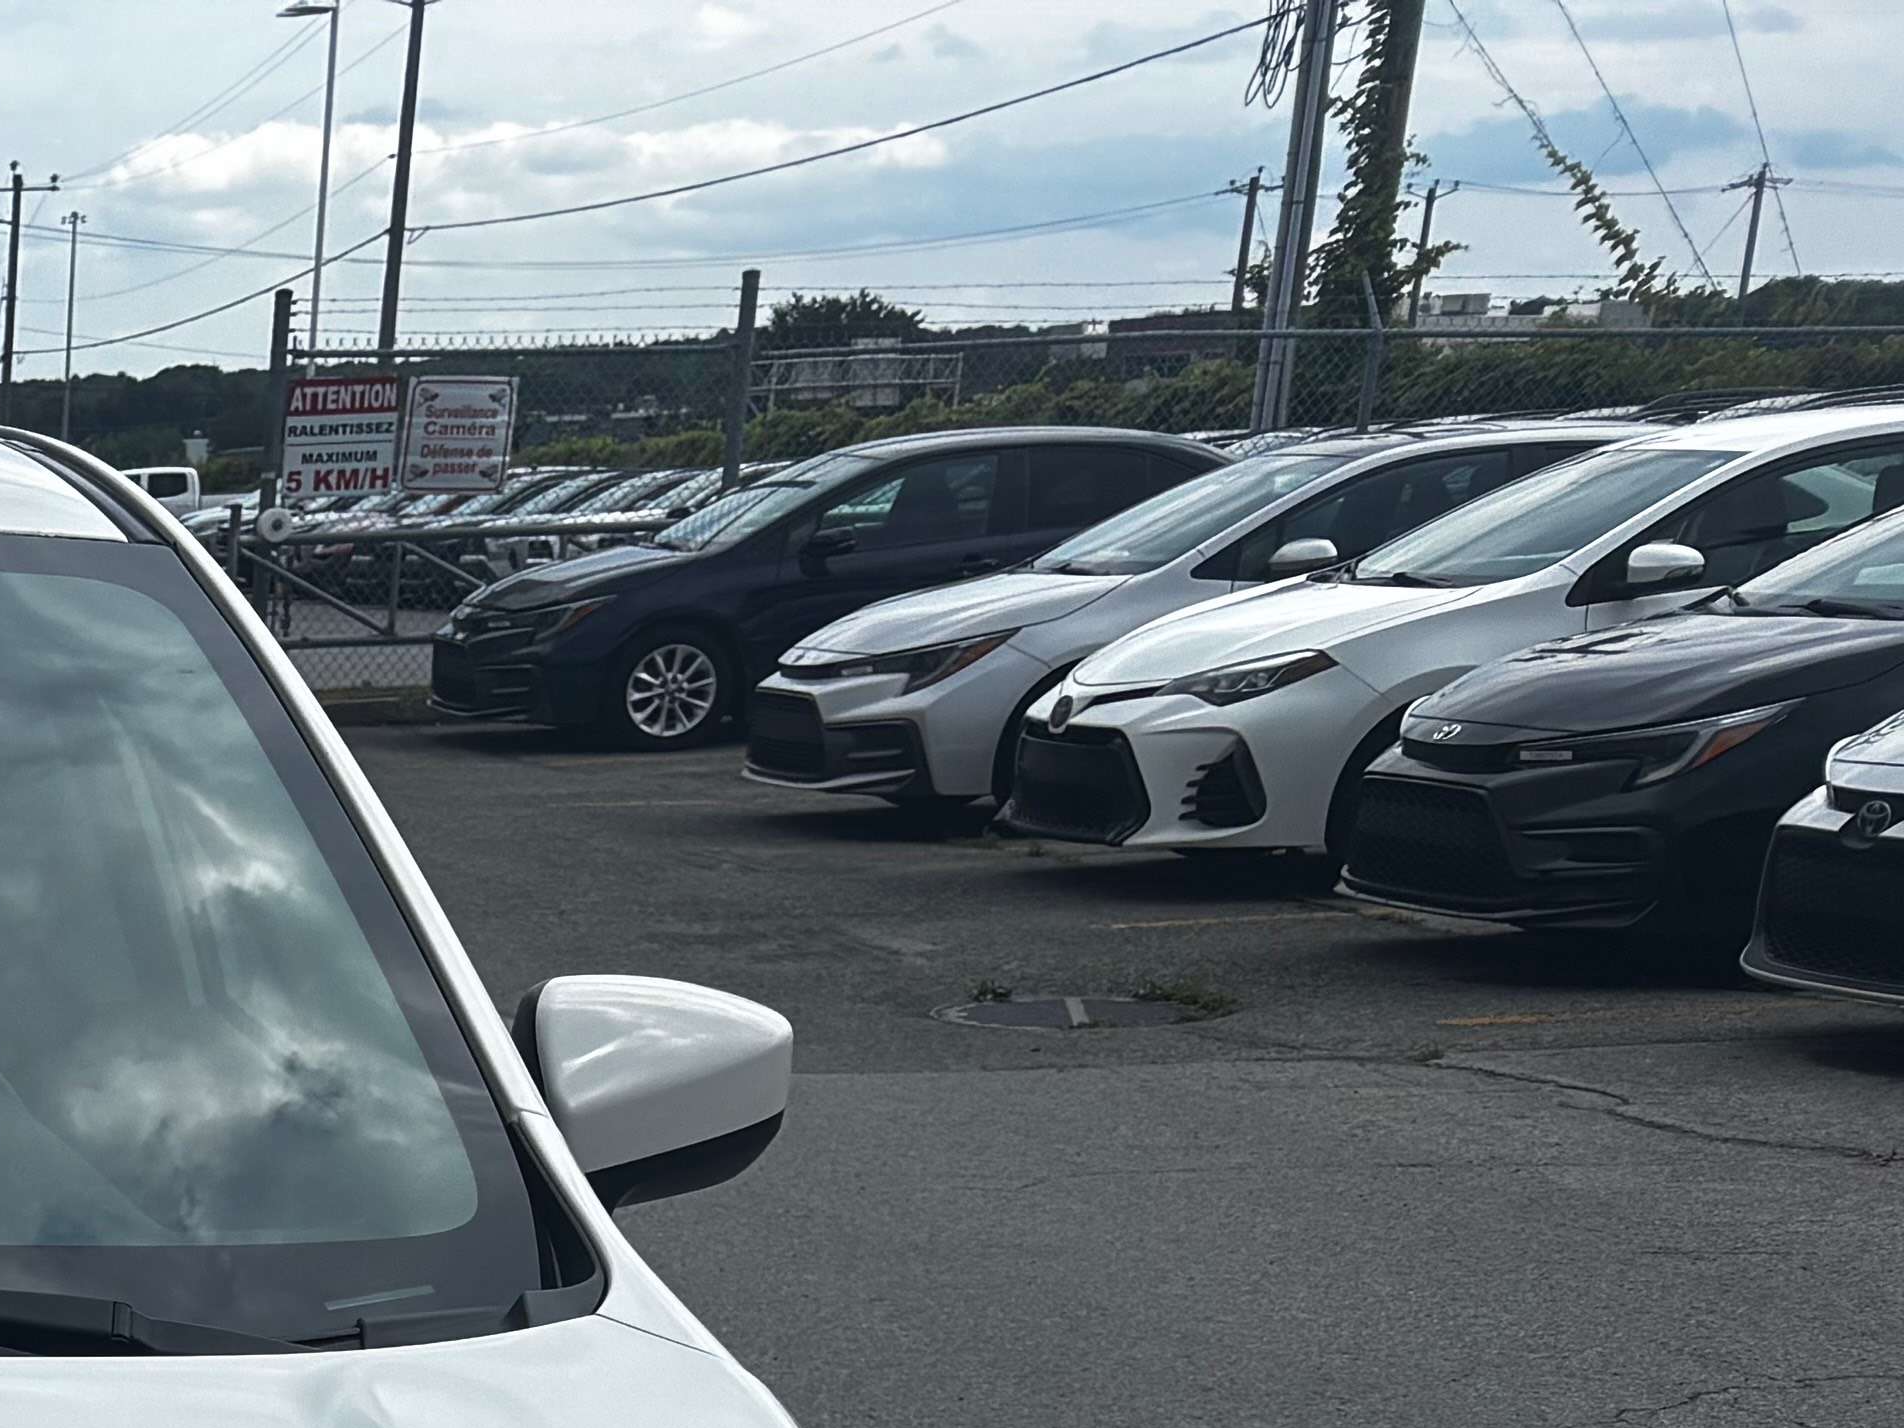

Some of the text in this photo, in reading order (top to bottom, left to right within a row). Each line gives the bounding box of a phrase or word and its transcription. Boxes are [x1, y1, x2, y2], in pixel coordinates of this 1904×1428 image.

[289, 383, 397, 412] ATTENTION
[424, 404, 499, 418] Surveillance
[287, 422, 395, 438] RALENTISSEZ
[423, 420, 496, 436] Caméra
[301, 450, 378, 464] MAXIMUM
[420, 444, 494, 458] Défense de
[432, 463, 479, 477] passer
[285, 467, 390, 492] 5 KM/H
